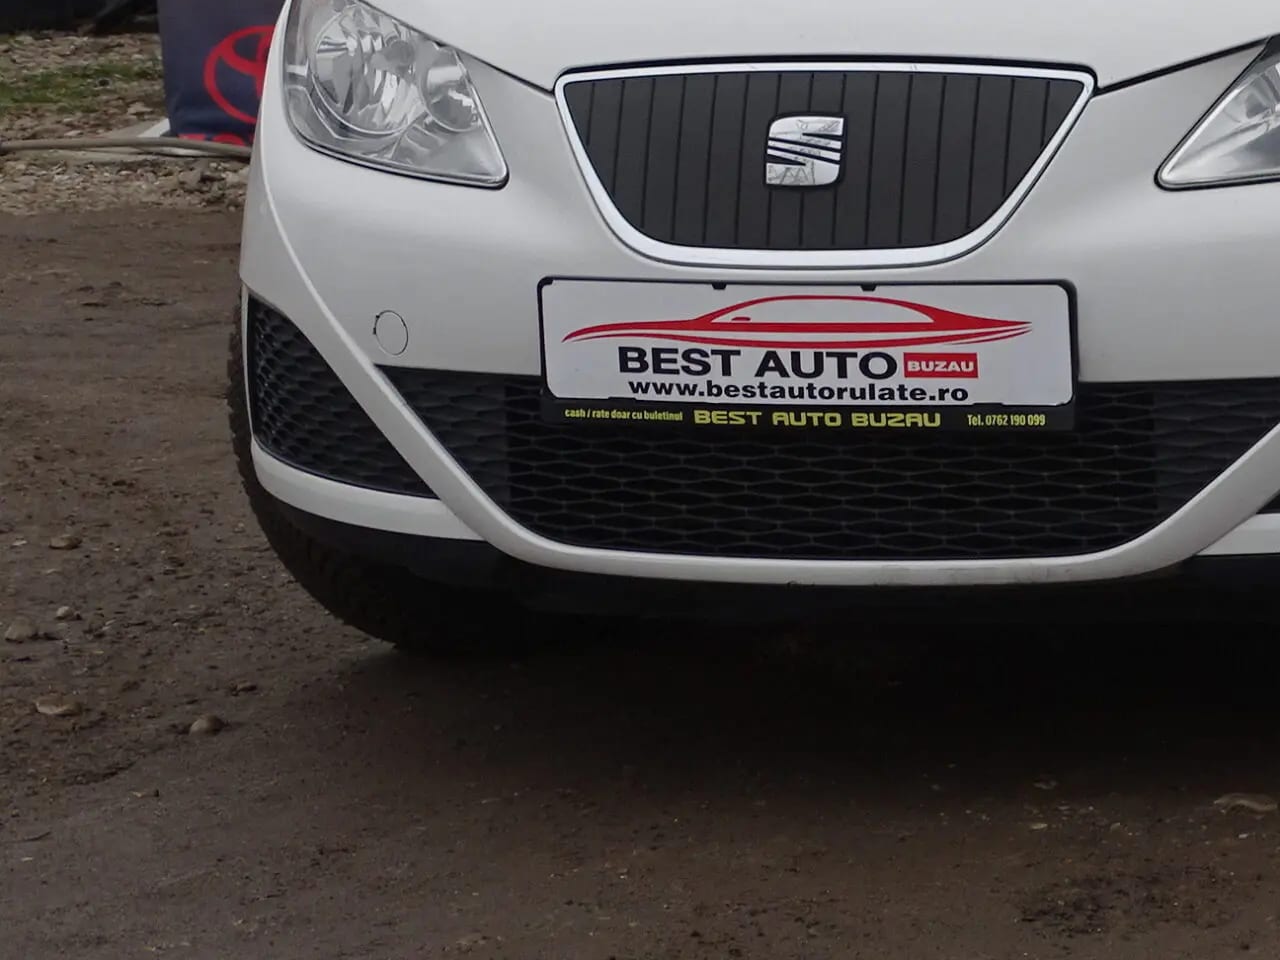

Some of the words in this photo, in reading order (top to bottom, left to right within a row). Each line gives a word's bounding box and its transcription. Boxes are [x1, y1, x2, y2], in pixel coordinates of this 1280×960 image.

[618, 346, 741, 376] BEST
[754, 349, 898, 380] AUTO
[906, 360, 975, 373] BUZAU
[628, 380, 969, 402] www.bestautorulate.ro
[564, 409, 586, 418] cash
[592, 409, 610, 419] rate
[611, 409, 631, 420] doar
[632, 411, 643, 420] cu
[694, 409, 762, 425] BEST
[772, 411, 843, 427] AUTO
[851, 412, 941, 428] BUZAU
[967, 414, 984, 426] Tel.
[985, 414, 1008, 427] 0762
[1010, 414, 1026, 427] 190
[1027, 414, 1046, 427] 099
